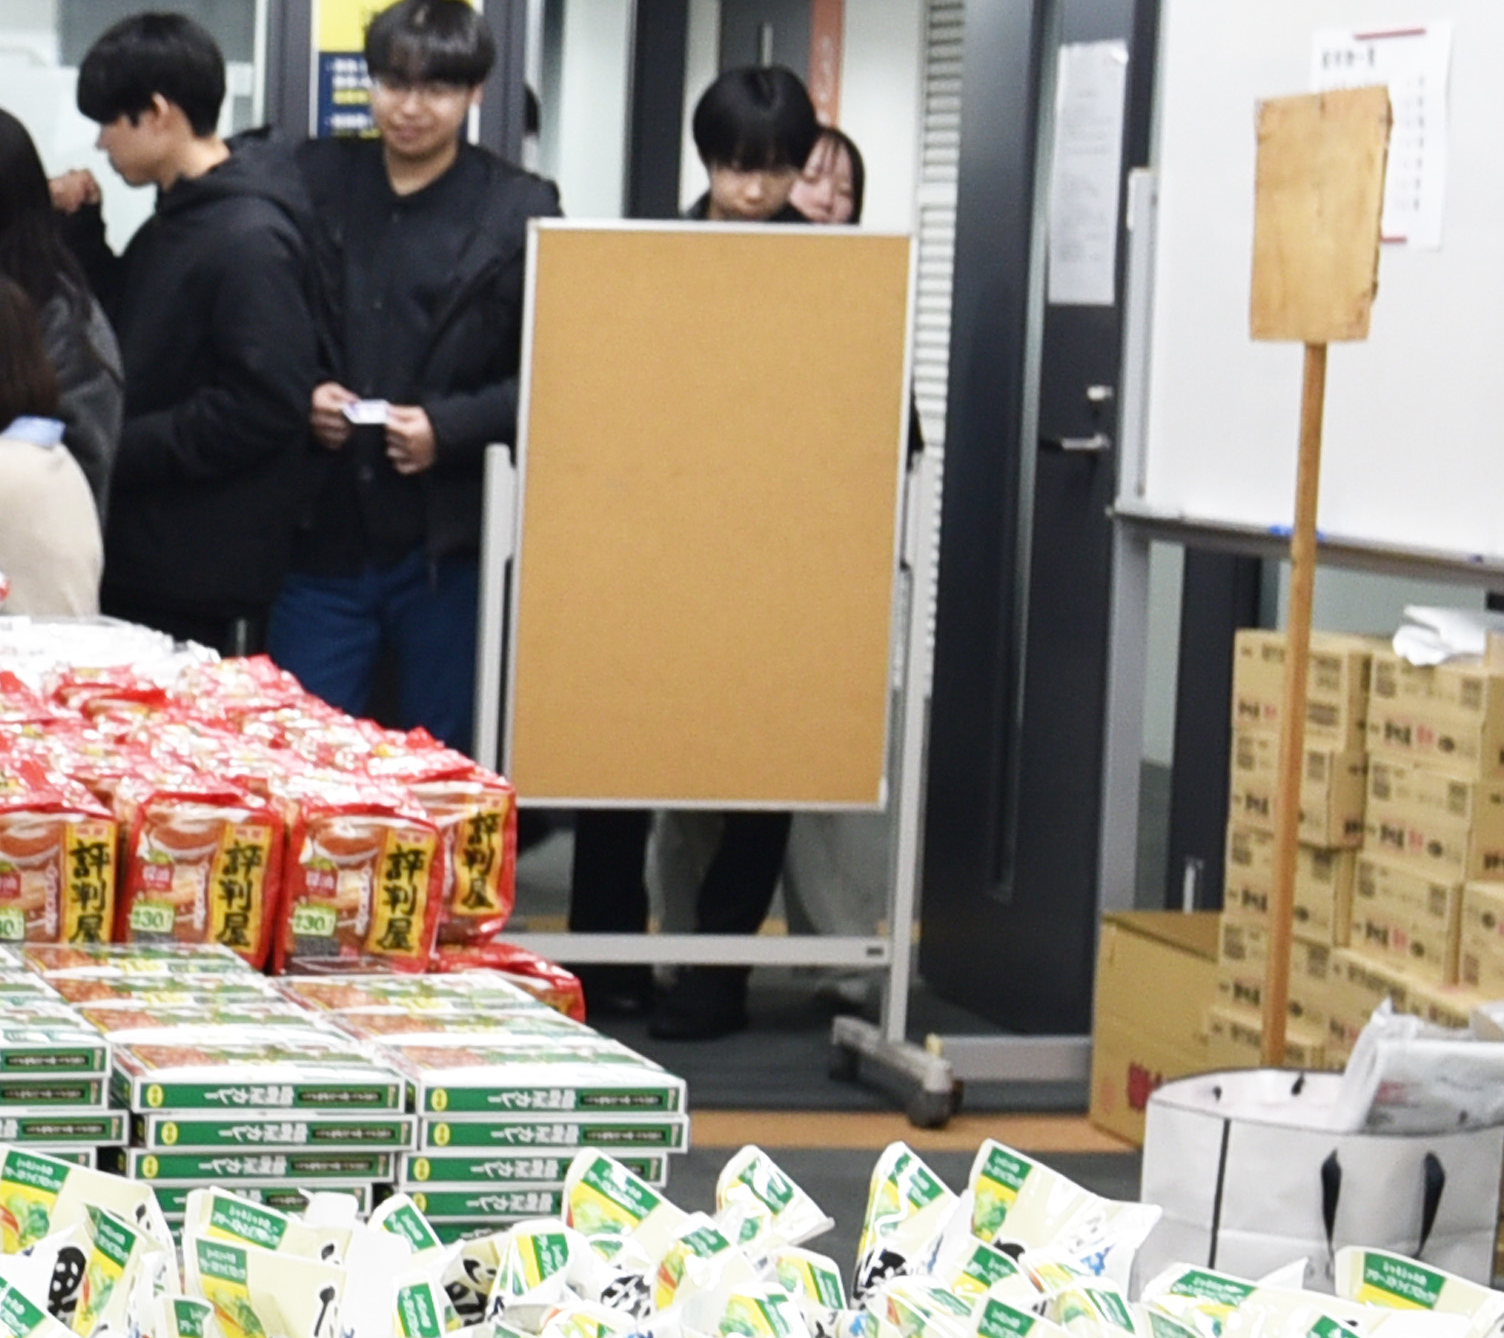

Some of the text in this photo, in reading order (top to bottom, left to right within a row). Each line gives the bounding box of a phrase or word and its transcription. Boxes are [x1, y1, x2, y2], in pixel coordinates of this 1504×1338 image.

[215, 840, 264, 949] 評判屋
[376, 844, 424, 953] 評判屋
